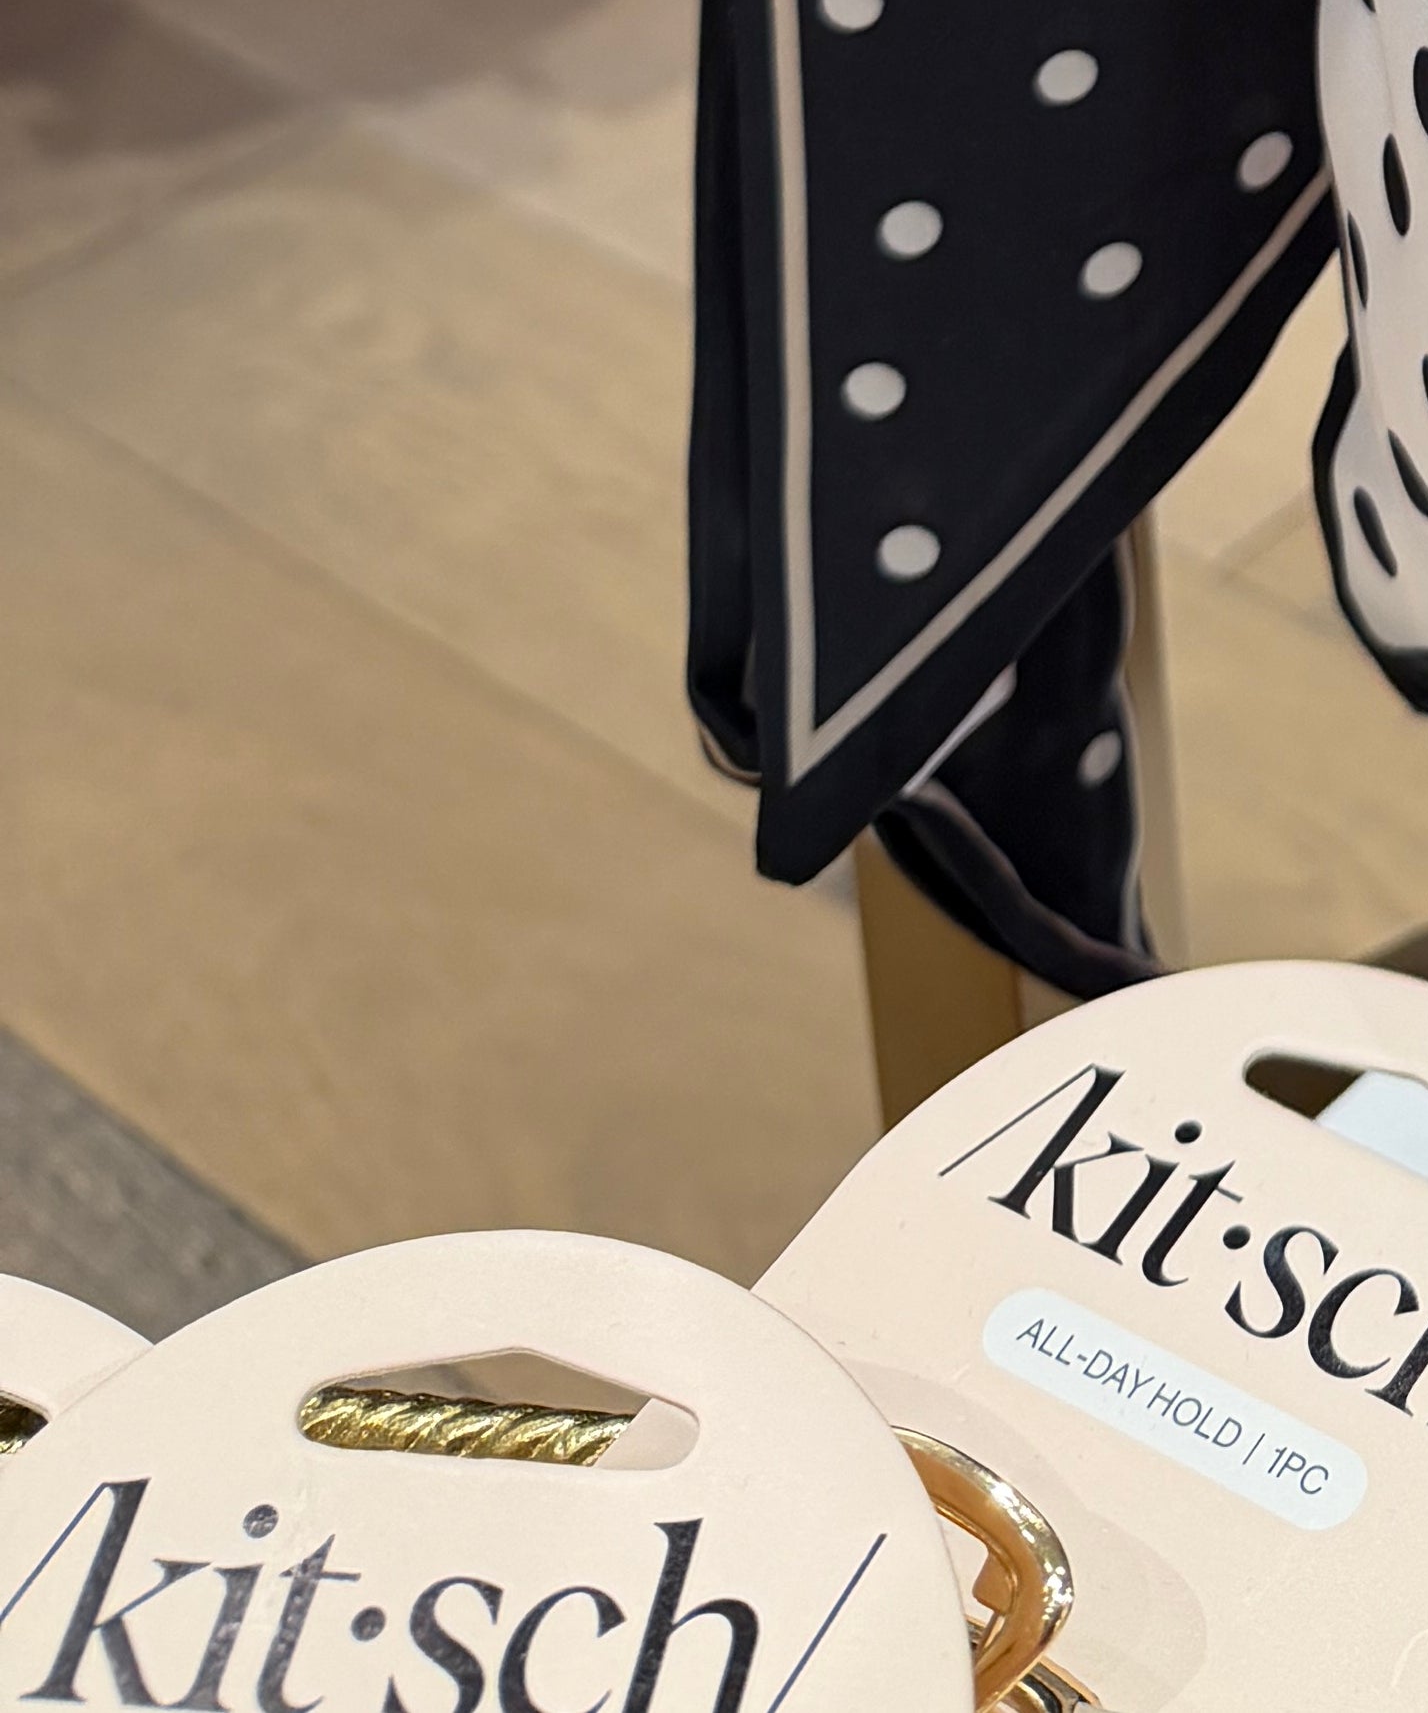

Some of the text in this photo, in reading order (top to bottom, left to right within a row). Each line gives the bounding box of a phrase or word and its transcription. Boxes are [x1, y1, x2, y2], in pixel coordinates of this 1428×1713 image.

[1016, 1318, 1155, 1399] ALL-DAY
[1146, 1382, 1243, 1448] HOLD
[1267, 1446, 1329, 1495] 1PC
